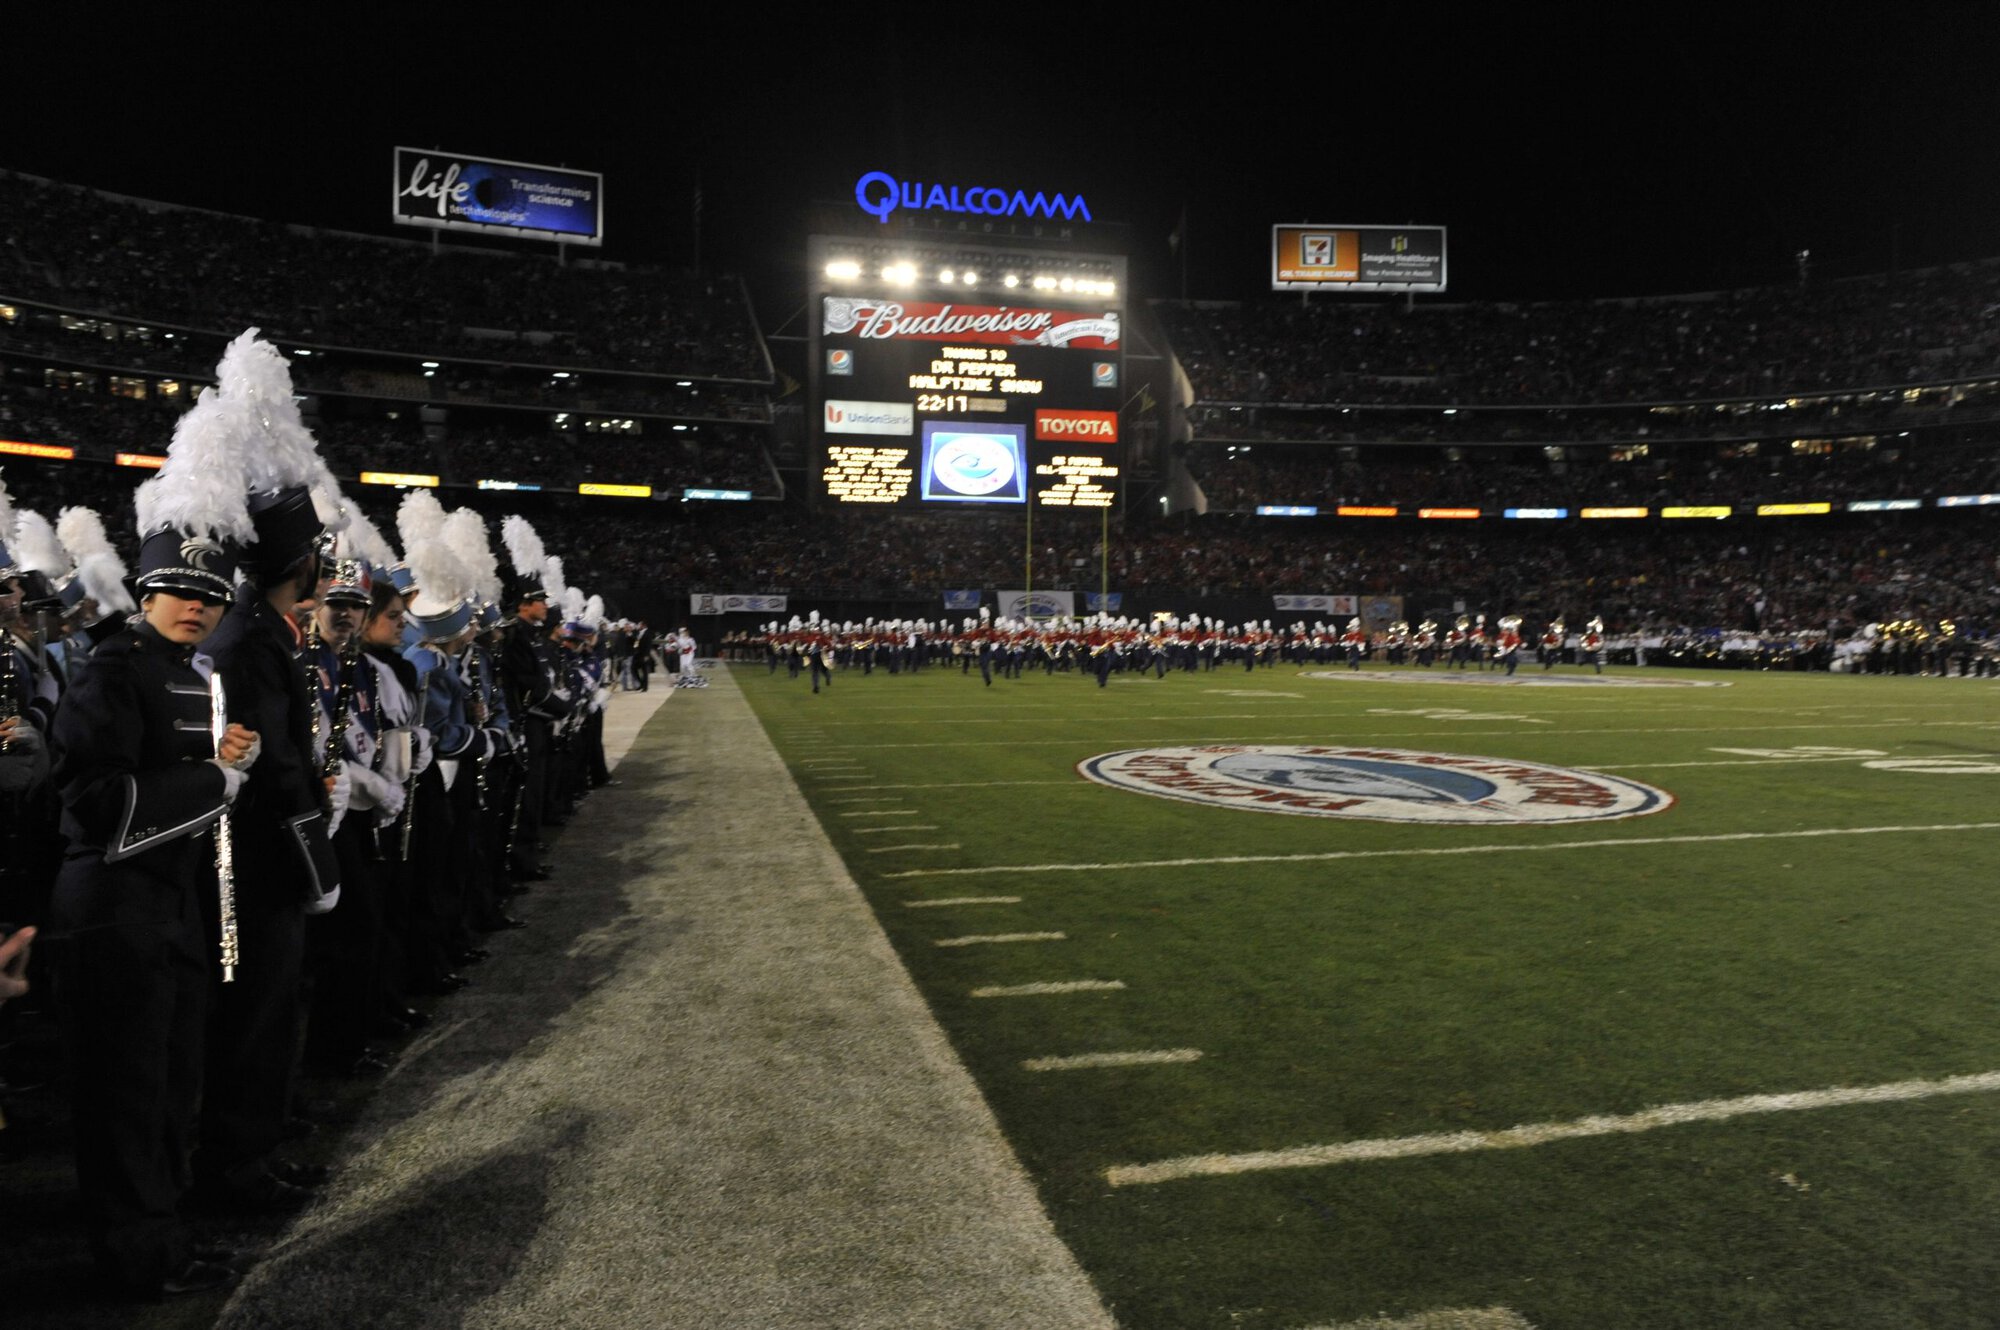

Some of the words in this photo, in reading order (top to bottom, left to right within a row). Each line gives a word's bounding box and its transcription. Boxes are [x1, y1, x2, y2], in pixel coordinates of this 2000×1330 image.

[398, 158, 471, 217] life
[509, 178, 592, 201] Transforming
[528, 193, 574, 208] science
[855, 171, 1092, 224] QUALCOMM
[449, 204, 527, 222] technologies
[1361, 252, 1395, 264] Imaging
[851, 304, 1051, 339] Budweiser
[942, 347, 987, 360] THANKS
[990, 350, 1007, 361] TO
[931, 360, 954, 374] DR
[959, 362, 1016, 377] PEPPER
[909, 375, 993, 392] HALFTIME
[1000, 379, 1043, 394] SHOW
[847, 411, 911, 425] UnionBank
[1039, 417, 1114, 436] TOYOTA
